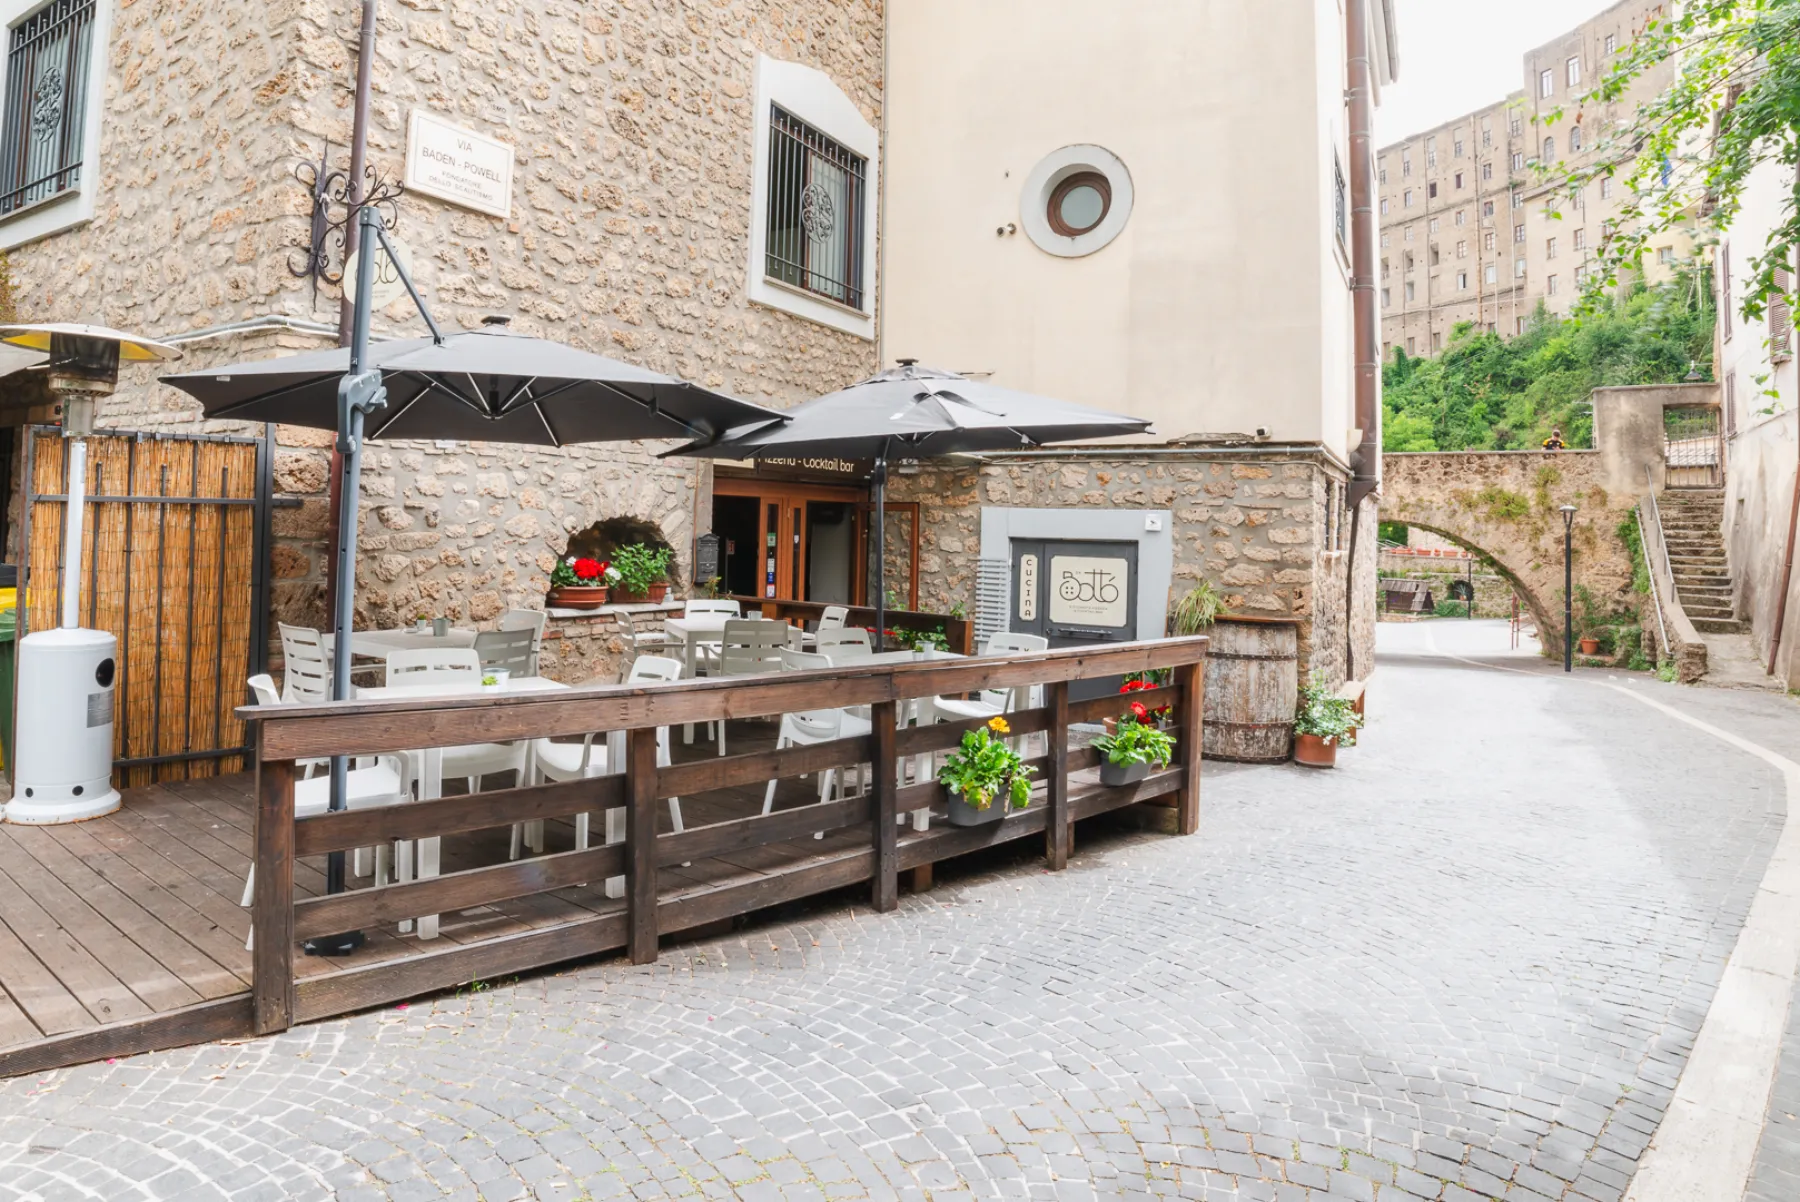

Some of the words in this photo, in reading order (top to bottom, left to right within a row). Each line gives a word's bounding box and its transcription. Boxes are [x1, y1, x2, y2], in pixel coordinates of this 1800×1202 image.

[457, 138, 473, 153] VIA
[422, 146, 456, 167] BADEN
[464, 161, 502, 183] POWELL
[803, 457, 839, 471] Cocktail
[840, 458, 854, 472] bar
